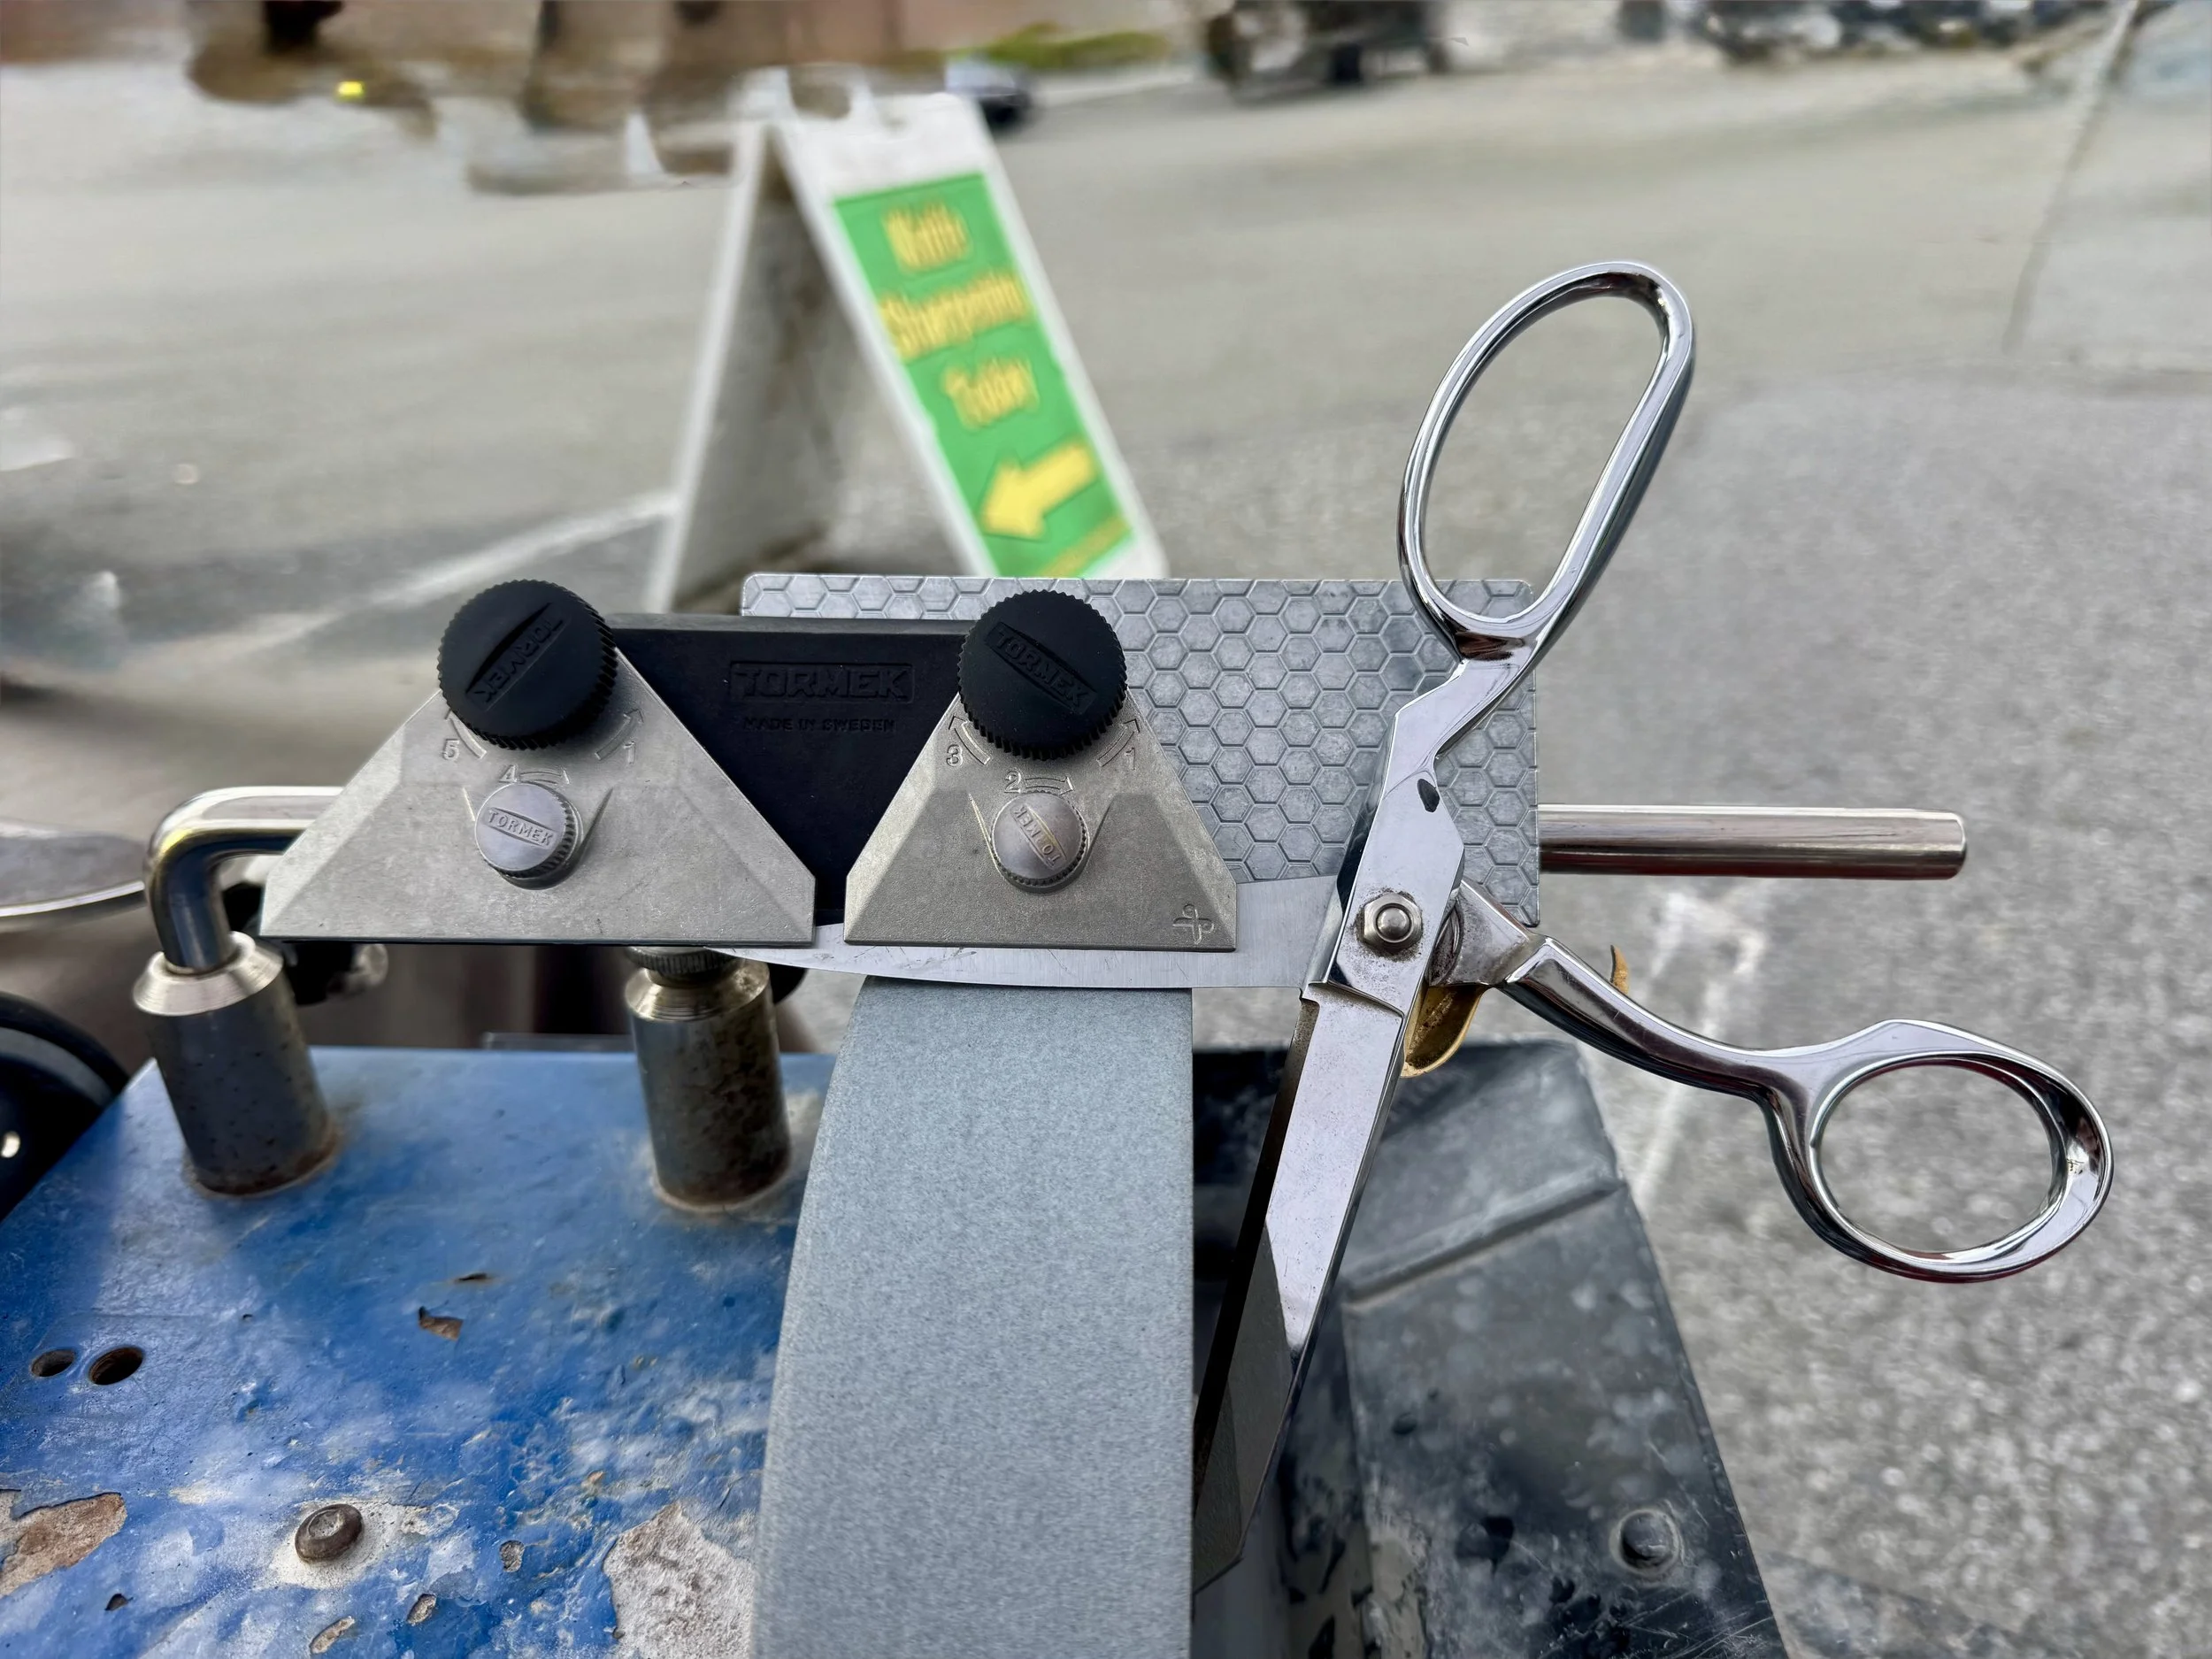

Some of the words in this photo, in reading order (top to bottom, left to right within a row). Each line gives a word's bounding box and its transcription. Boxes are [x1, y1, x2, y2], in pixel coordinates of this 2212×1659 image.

[474, 618, 564, 703] TORMEK
[996, 629, 1090, 707] TORMEK
[733, 668, 909, 699] TORMEK
[744, 718, 793, 731] MADE
[798, 718, 816, 731] IN
[442, 740, 460, 762] 5
[946, 744, 964, 767] 3
[500, 764, 518, 783] 4
[1004, 771, 1023, 794] 2
[488, 809, 554, 848] TORMEK
[1014, 805, 1065, 867] TORMEK
